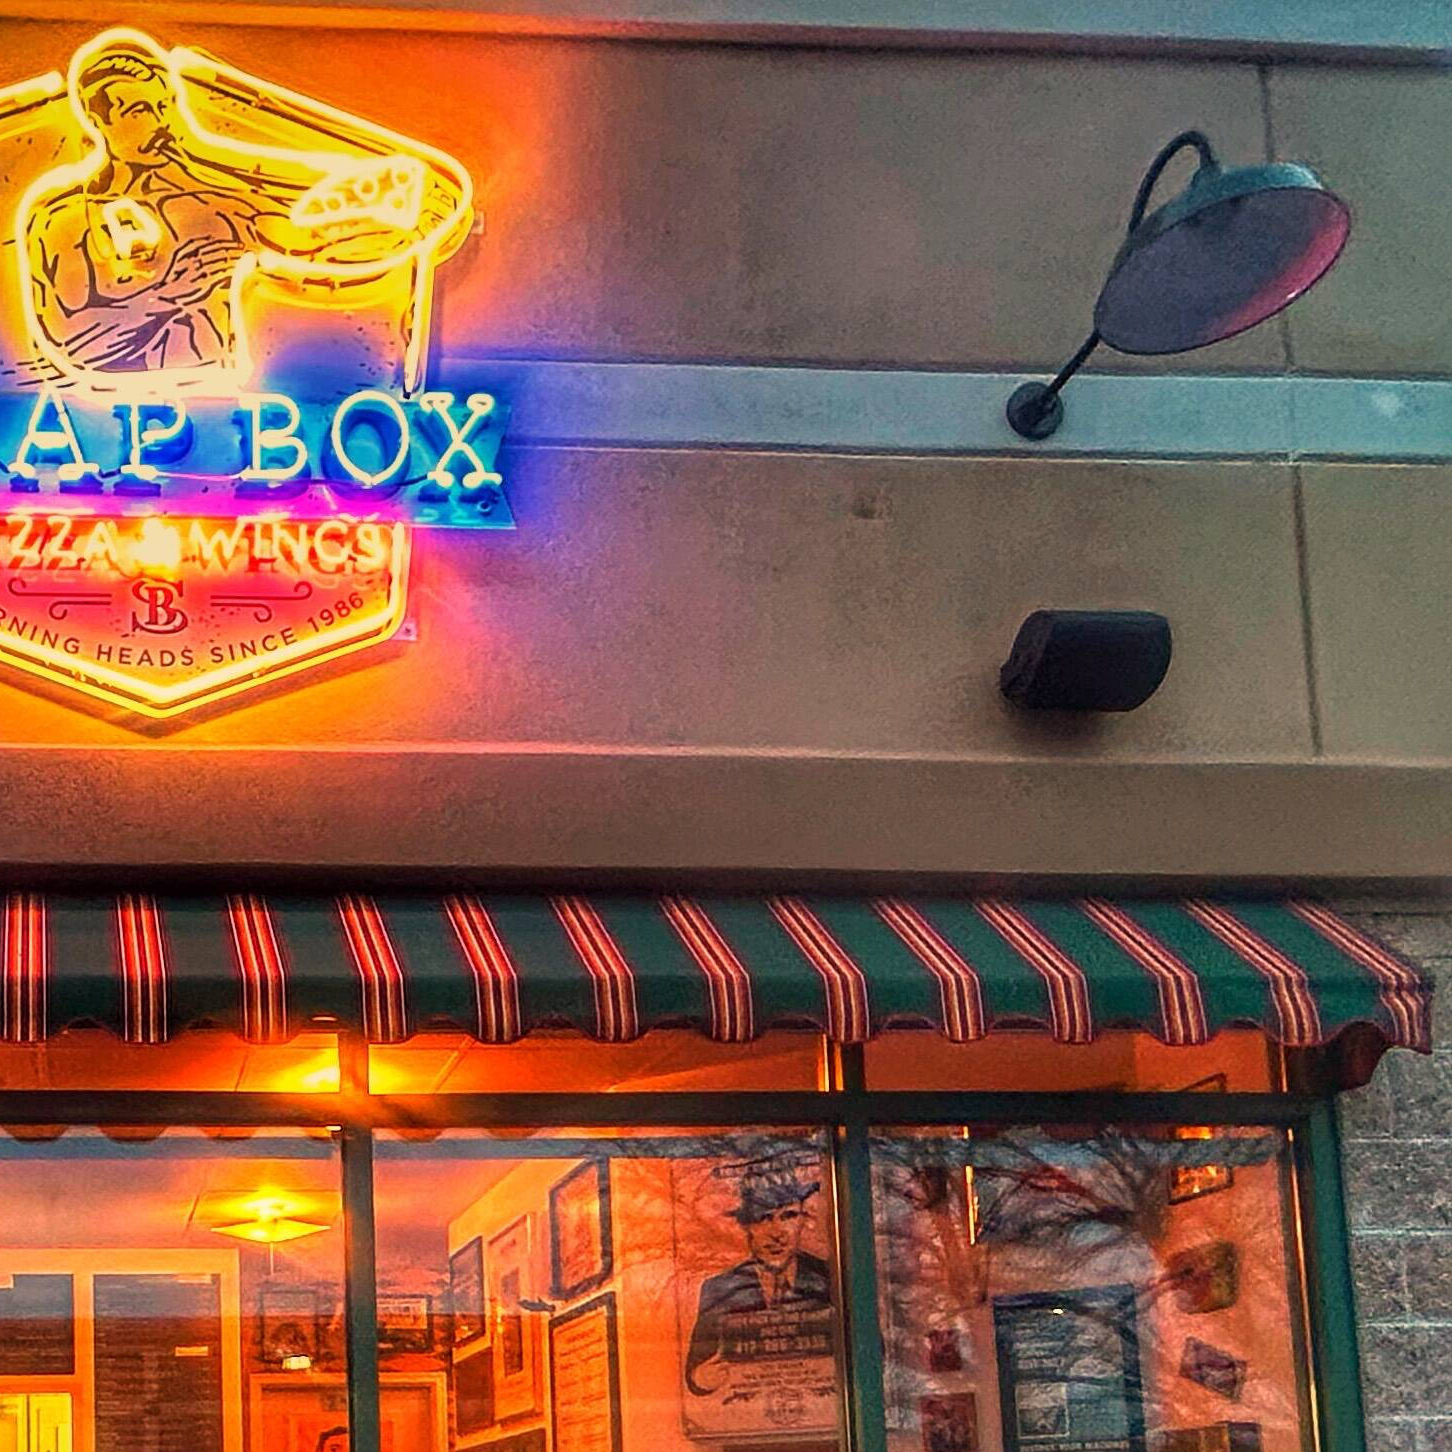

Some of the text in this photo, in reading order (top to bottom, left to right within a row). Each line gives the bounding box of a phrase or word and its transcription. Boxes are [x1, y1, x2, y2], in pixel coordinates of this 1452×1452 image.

[238, 390, 503, 488] BOX
[189, 517, 387, 567] WINGS
[96, 644, 194, 667] HEADS
[211, 627, 298, 664] SINCE
[306, 592, 365, 633] 1986
